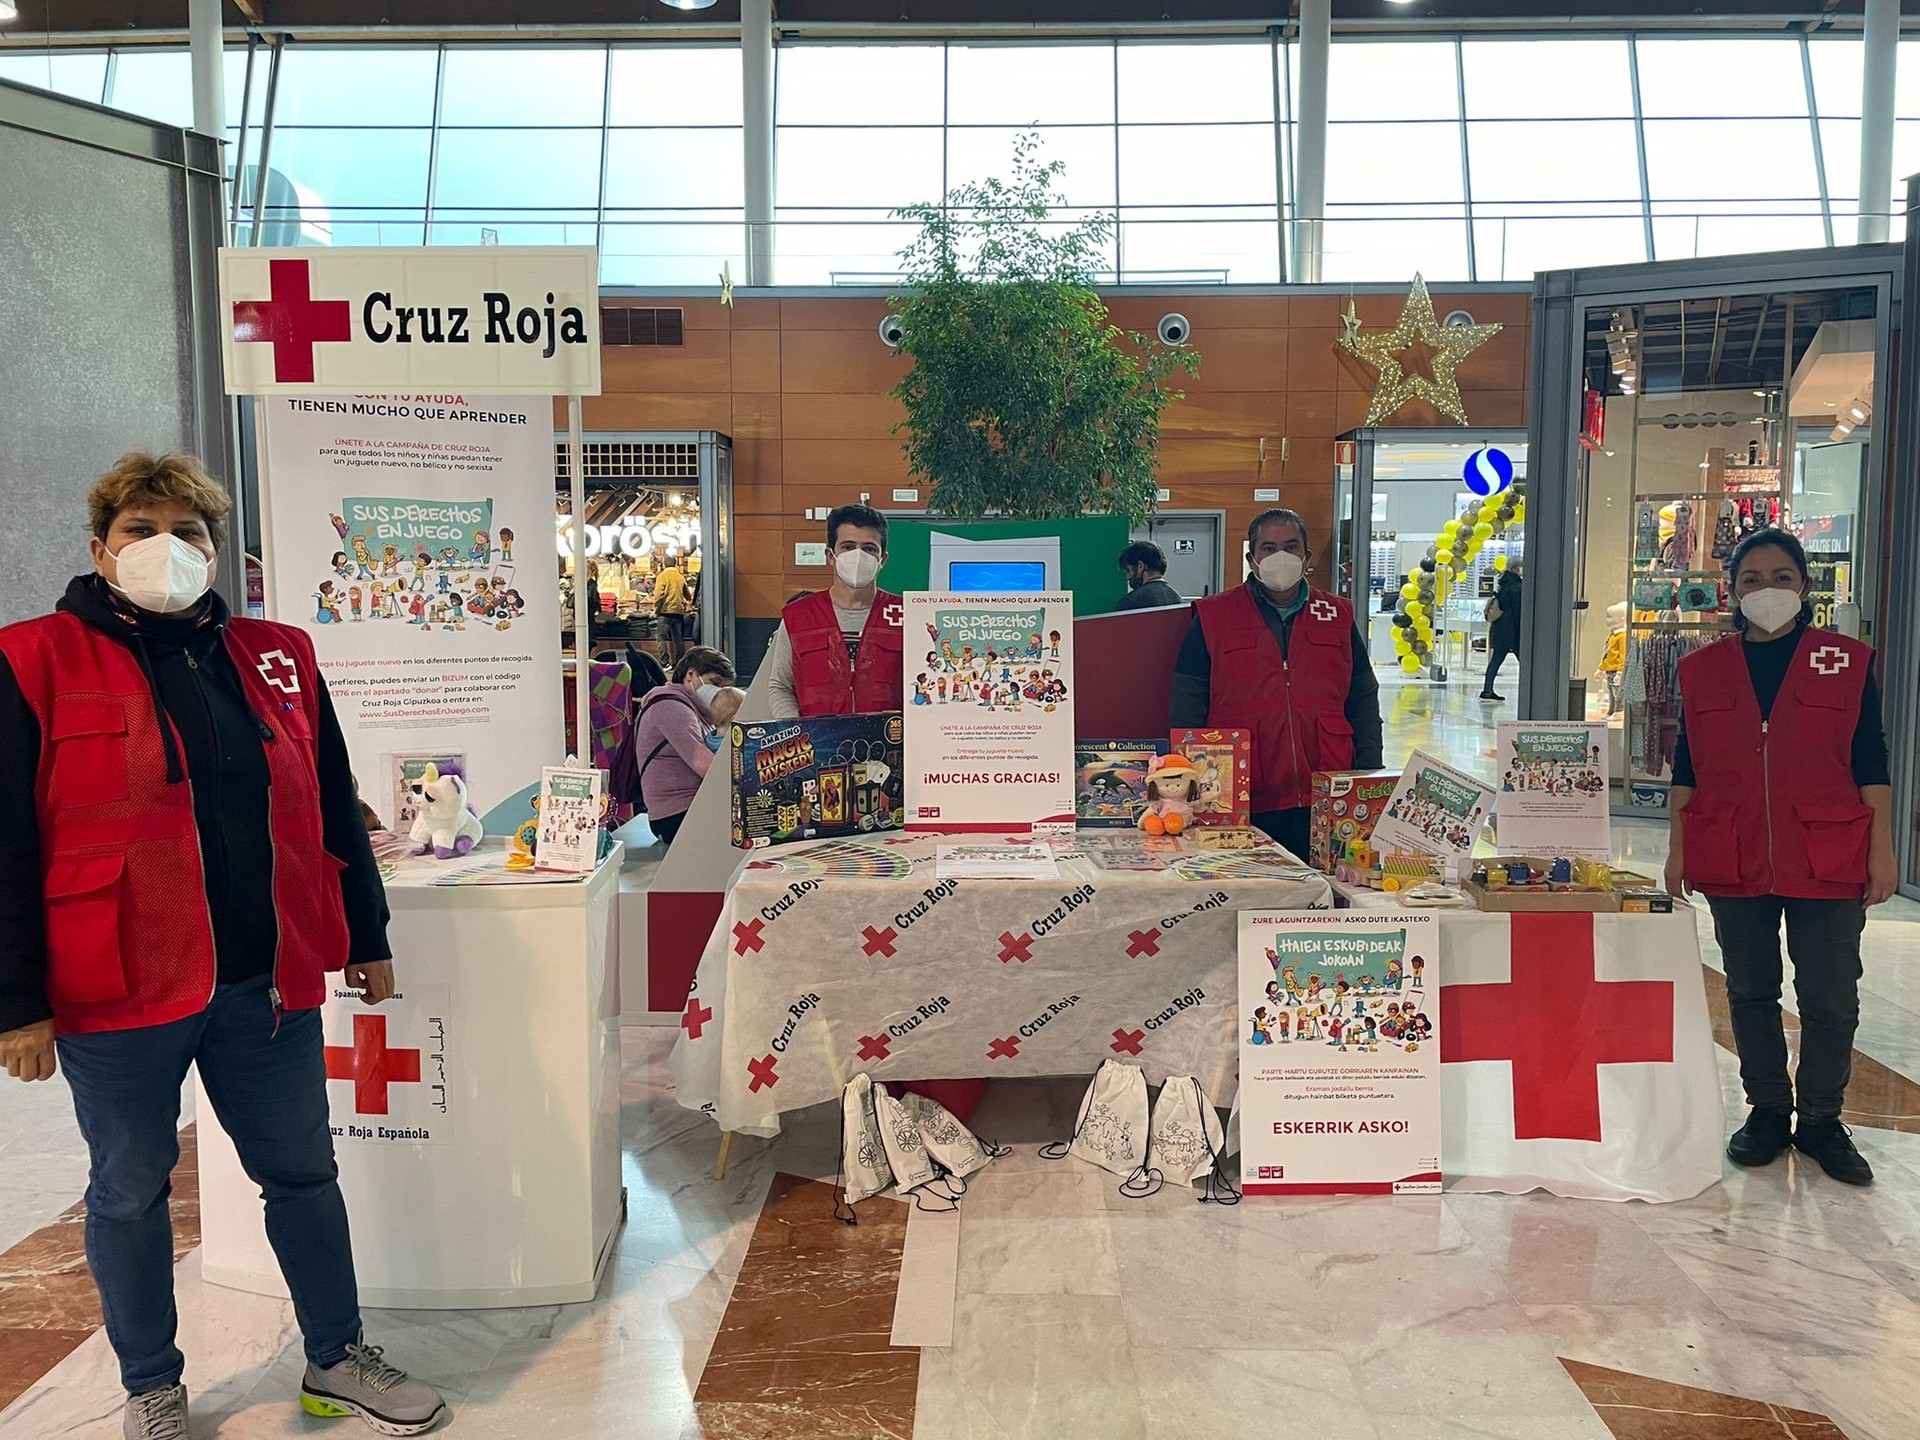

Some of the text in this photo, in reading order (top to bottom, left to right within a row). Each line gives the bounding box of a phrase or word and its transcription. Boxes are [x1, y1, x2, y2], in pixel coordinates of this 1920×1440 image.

[362, 291, 588, 359] Cruz Roja
[288, 399, 527, 425] TIENEN MUCHO QUE APRENDER
[386, 441, 430, 450] CAMPAÑA
[444, 444, 467, 452] CRUZ
[469, 445, 491, 453] ROJA
[340, 449, 357, 457] que
[358, 449, 381, 457] todos
[383, 450, 395, 458] los
[397, 450, 420, 459] niños
[427, 451, 449, 460] niñas
[450, 453, 481, 462] puedan
[482, 455, 503, 463] tener
[346, 458, 380, 467] juguete
[380, 460, 409, 468] nuevo,
[422, 460, 447, 469] bélico
[448, 463, 454, 471] y
[466, 463, 493, 471] sexista
[352, 504, 482, 524] SUS DERECHOS
[377, 522, 463, 540] EN JUEGO
[942, 614, 1037, 629] SUS DERECHOS
[959, 629, 1022, 642] EN JUEGO
[345, 660, 376, 668] juguete
[426, 657, 463, 665] diferentes
[464, 656, 490, 664] puntos
[501, 655, 532, 663] recogida
[370, 677, 401, 686] puedes
[402, 675, 428, 683] enviar
[494, 672, 521, 680] código
[372, 687, 411, 697] apartado
[463, 684, 500, 692] colaborar
[361, 699, 381, 707] Cruz
[383, 699, 401, 707] Roja
[403, 697, 441, 706] Gipuzkoa
[359, 705, 490, 718] www.SusDerechosEnJuego.com
[761, 726, 801, 747] AMAZING
[1521, 734, 1584, 744] SUS DERECHOS
[756, 733, 813, 771] MAGIC
[1075, 742, 1156, 751] orescent Collection
[1545, 744, 1574, 752] JUEGO
[758, 749, 815, 785] MYSTERY
[993, 772, 1060, 784] GRACIAS!
[1424, 771, 1440, 784] SUS
[1440, 777, 1476, 801] DERECHOS
[1429, 784, 1463, 805] EN JUEGO
[760, 893, 795, 921] Cruz
[894, 878, 959, 930] Cruz Roja
[1031, 882, 1096, 937] Cruz Roja
[1279, 938, 1402, 953] HAIEN ESKUBIDEAK
[1318, 954, 1364, 966] JOKOAN
[334, 989, 363, 999] Spanish
[888, 994, 951, 1039] Cruz Roja
[1019, 993, 1081, 1038] Cruz Roja
[1144, 987, 1206, 1031] Cruz Roja
[771, 991, 821, 1053] Cruz Roja
[330, 1125, 430, 1141] uz Roja Española
[1273, 1120, 1409, 1134] ESKERRIK ASKO!
